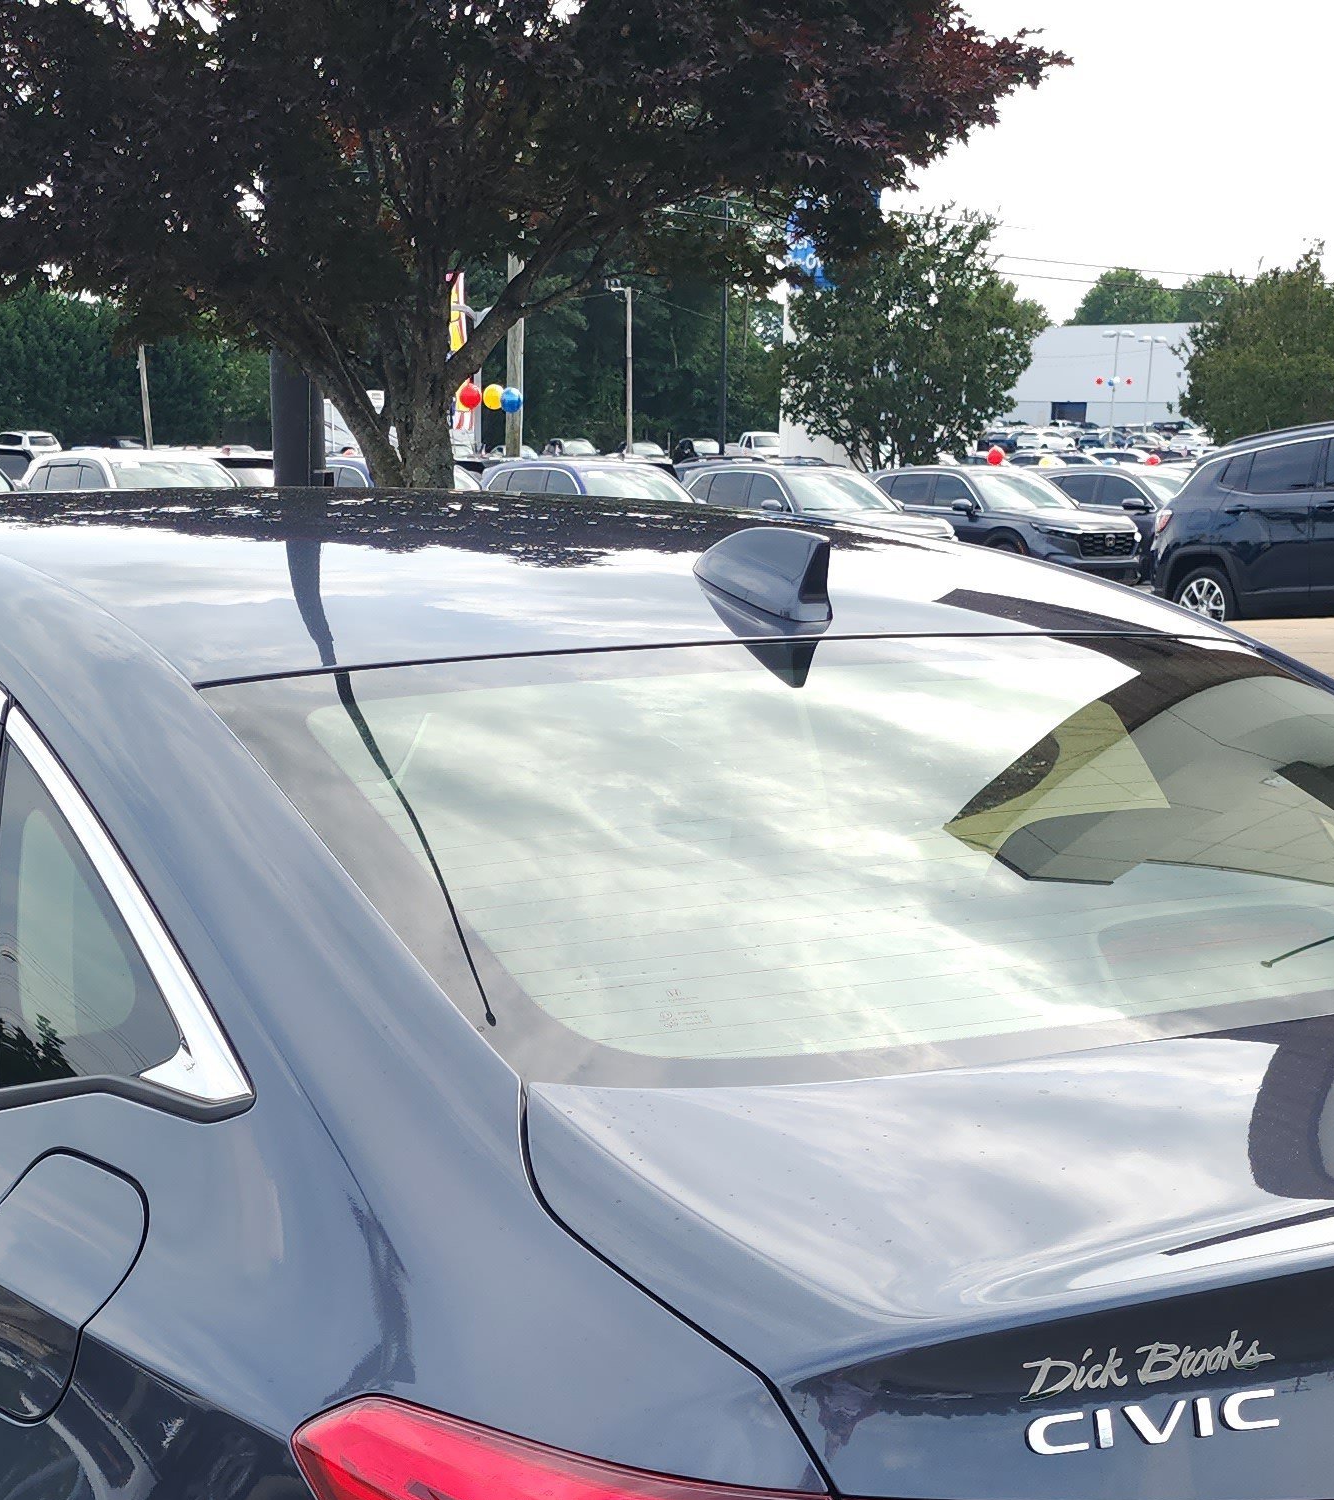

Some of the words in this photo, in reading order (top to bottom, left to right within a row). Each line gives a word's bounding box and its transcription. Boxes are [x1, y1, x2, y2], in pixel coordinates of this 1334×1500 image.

[1019, 1347, 1129, 1403] Dick
[1135, 1329, 1276, 1386] Brooks
[1024, 1388, 1280, 1456] CIVIC
